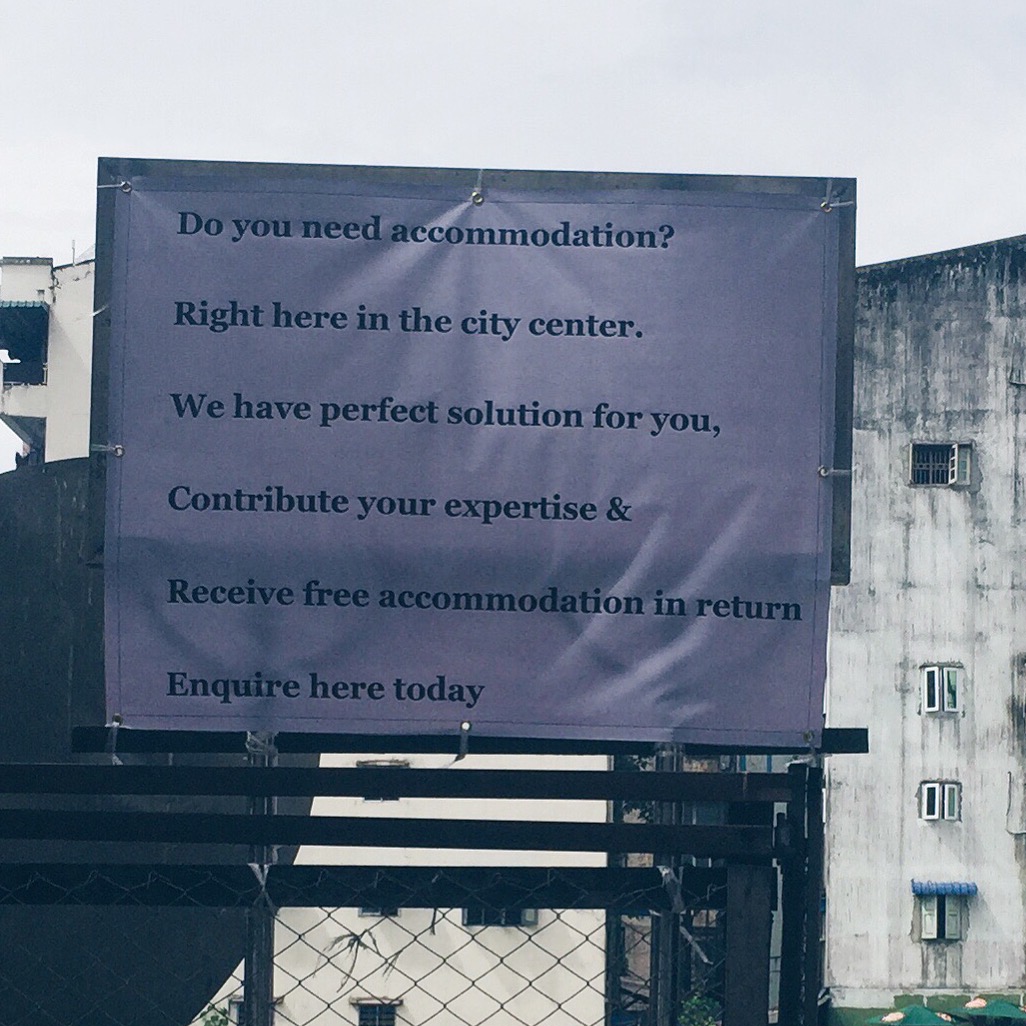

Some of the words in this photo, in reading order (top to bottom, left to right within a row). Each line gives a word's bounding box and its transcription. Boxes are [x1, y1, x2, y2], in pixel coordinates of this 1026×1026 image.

[177, 212, 223, 235] Do
[232, 220, 291, 242] you
[302, 215, 382, 240] need
[391, 221, 674, 248] accommodation?
[174, 300, 264, 333] Right
[272, 302, 347, 329] here
[357, 305, 390, 330] in
[399, 307, 452, 333] the
[461, 310, 521, 341] city
[529, 315, 642, 338] center.
[170, 394, 224, 418] We
[233, 393, 311, 420] have
[320, 397, 439, 427] perfect
[447, 400, 584, 427] solution
[593, 403, 643, 429] for
[650, 413, 720, 438] you,
[169, 486, 348, 513] Contribute
[357, 497, 436, 520] your
[445, 494, 597, 524] expertise
[606, 497, 632, 521] &
[167, 579, 293, 605] Receive
[303, 580, 369, 607] free
[379, 587, 644, 614] accommodation
[654, 590, 687, 616] in
[696, 596, 802, 620] return
[167, 672, 299, 703] Enquire
[309, 673, 384, 700] here
[393, 676, 485, 708] today
